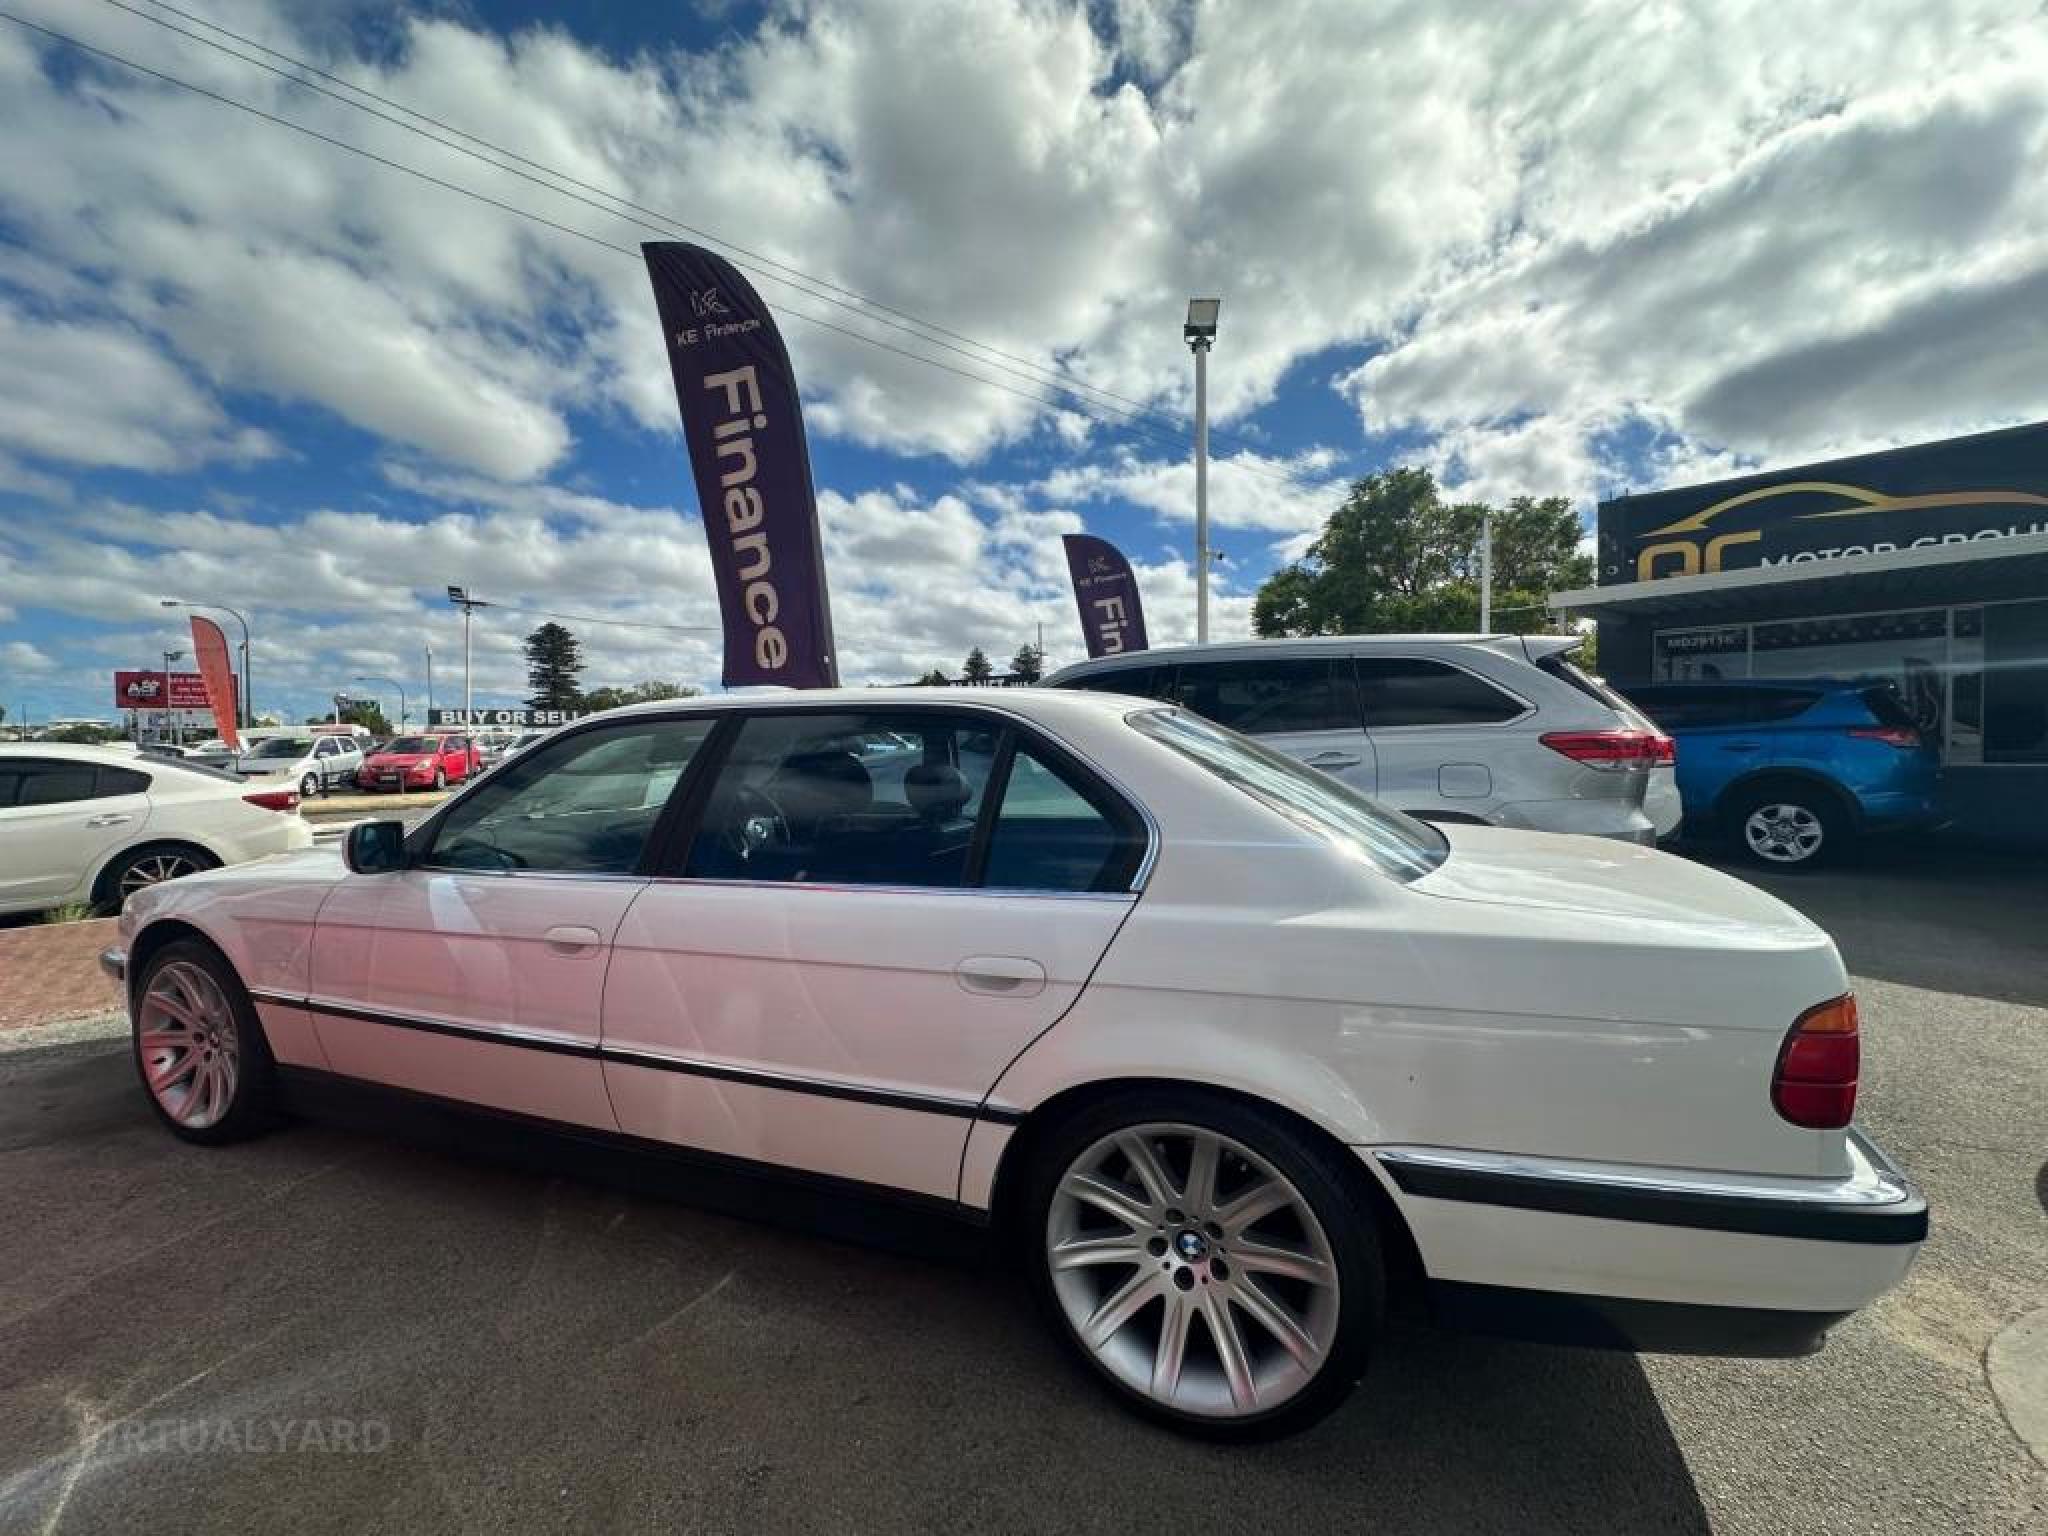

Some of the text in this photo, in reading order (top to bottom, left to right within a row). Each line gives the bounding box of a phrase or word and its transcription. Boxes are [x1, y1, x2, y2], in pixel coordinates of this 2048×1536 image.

[703, 366, 788, 669] Finance
[440, 711, 487, 724] BUY
[495, 711, 527, 724] OR
